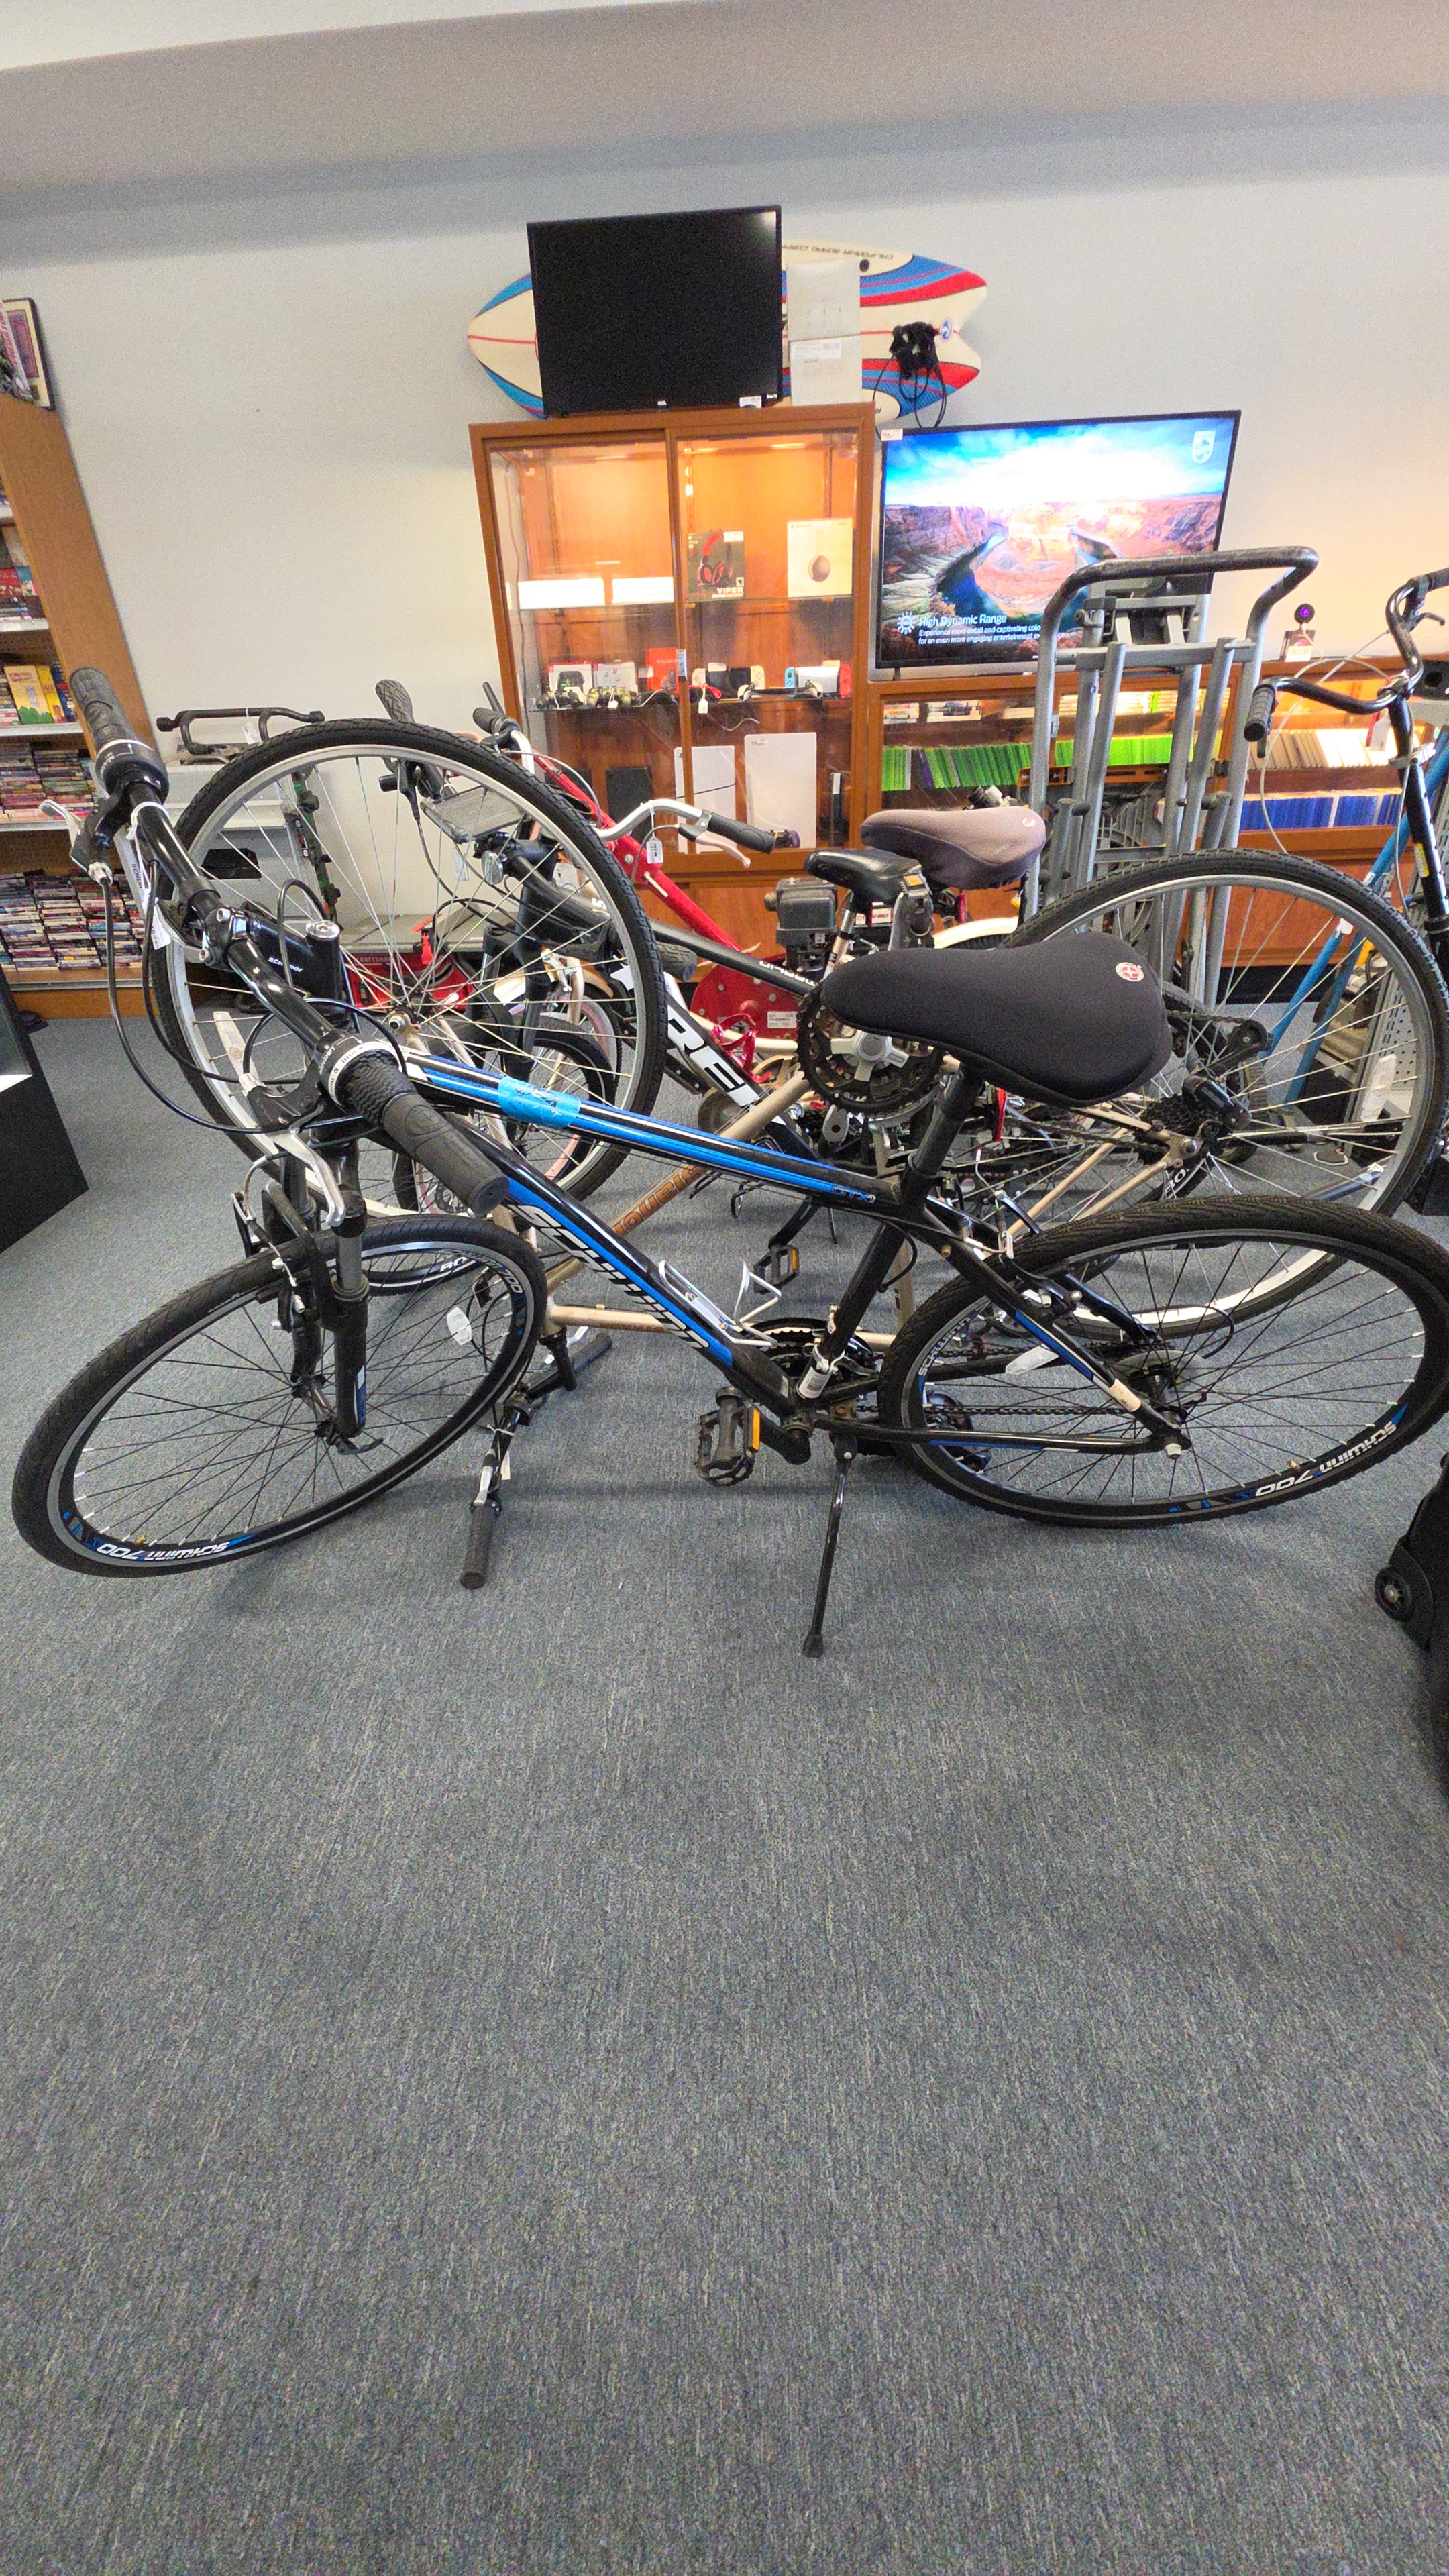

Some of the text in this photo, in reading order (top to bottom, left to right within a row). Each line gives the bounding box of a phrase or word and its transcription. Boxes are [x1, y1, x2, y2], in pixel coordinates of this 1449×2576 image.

[919, 616, 938, 627] High
[941, 614, 977, 627] Dynamic
[979, 614, 1007, 625] Range
[918, 629, 951, 637] Experience
[967, 626, 983, 634] detail
[996, 625, 1027, 633] captivating
[966, 635, 993, 643] engaging
[993, 633, 1033, 641] entertainment
[131, 863, 142, 889] HITACHI
[268, 957, 303, 973] SCHINN
[1255, 1468, 1313, 1498] 700
[97, 1543, 144, 1561] 700
